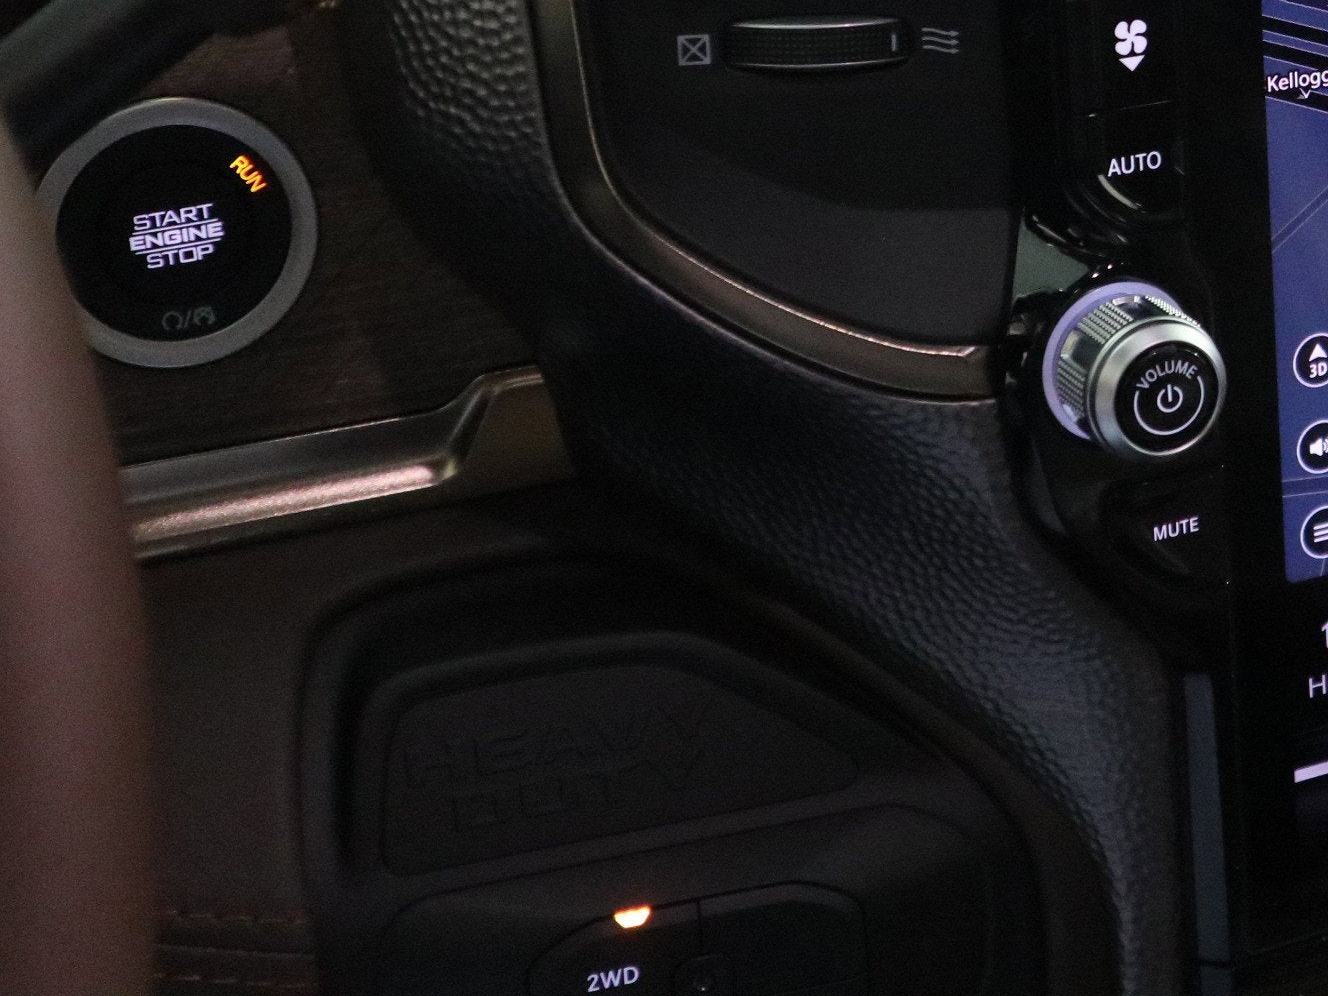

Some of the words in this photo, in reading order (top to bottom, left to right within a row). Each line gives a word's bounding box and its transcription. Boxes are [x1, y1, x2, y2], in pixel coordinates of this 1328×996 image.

[229, 155, 267, 193] RUN
[1107, 151, 1162, 177] AUTO
[133, 204, 214, 230] START
[129, 221, 224, 252] ENGINE
[146, 243, 216, 269] STOP
[1136, 359, 1199, 391] VOLUME
[1309, 362, 1328, 378] 3D
[1153, 516, 1200, 542] MUTE
[587, 966, 640, 992] 2WD
